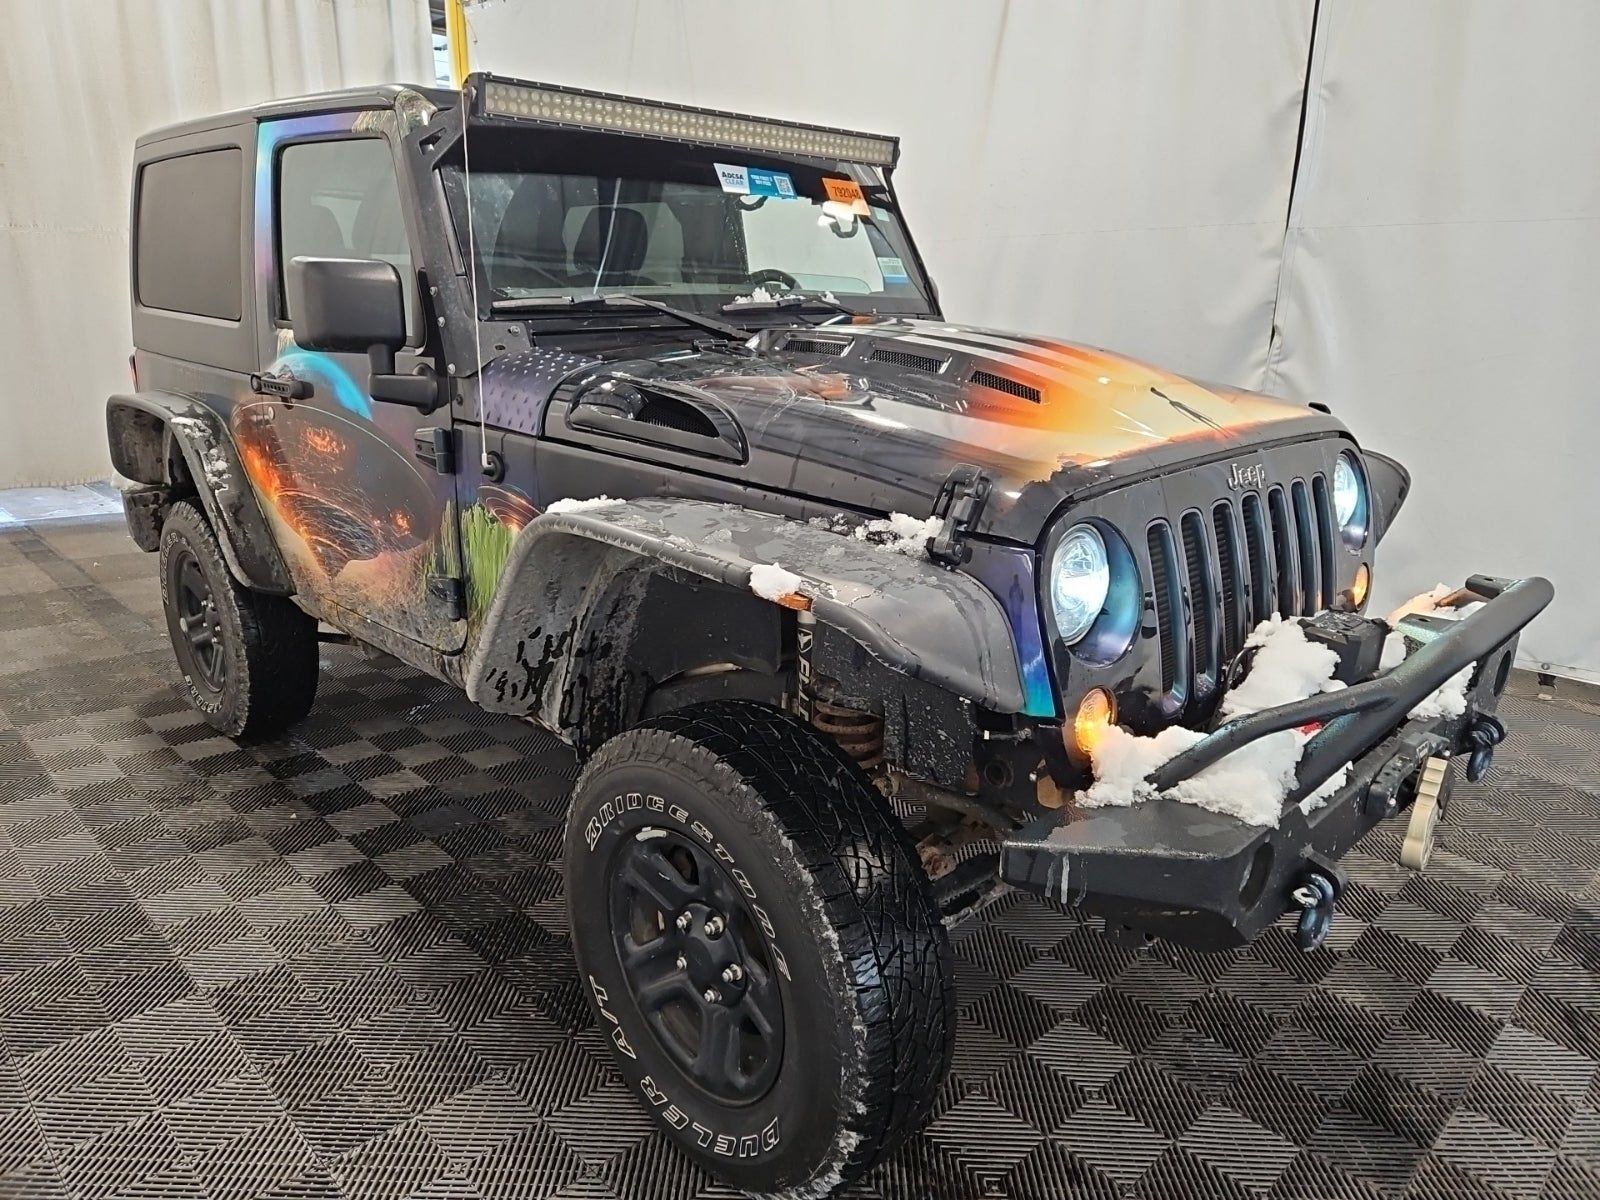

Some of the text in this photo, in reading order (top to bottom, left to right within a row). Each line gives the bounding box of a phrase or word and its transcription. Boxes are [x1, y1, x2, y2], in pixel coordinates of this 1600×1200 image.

[1227, 463, 1265, 490] Jeep
[585, 792, 793, 982] BRIDGESTONE
[589, 975, 780, 1158] DUELER A/T
